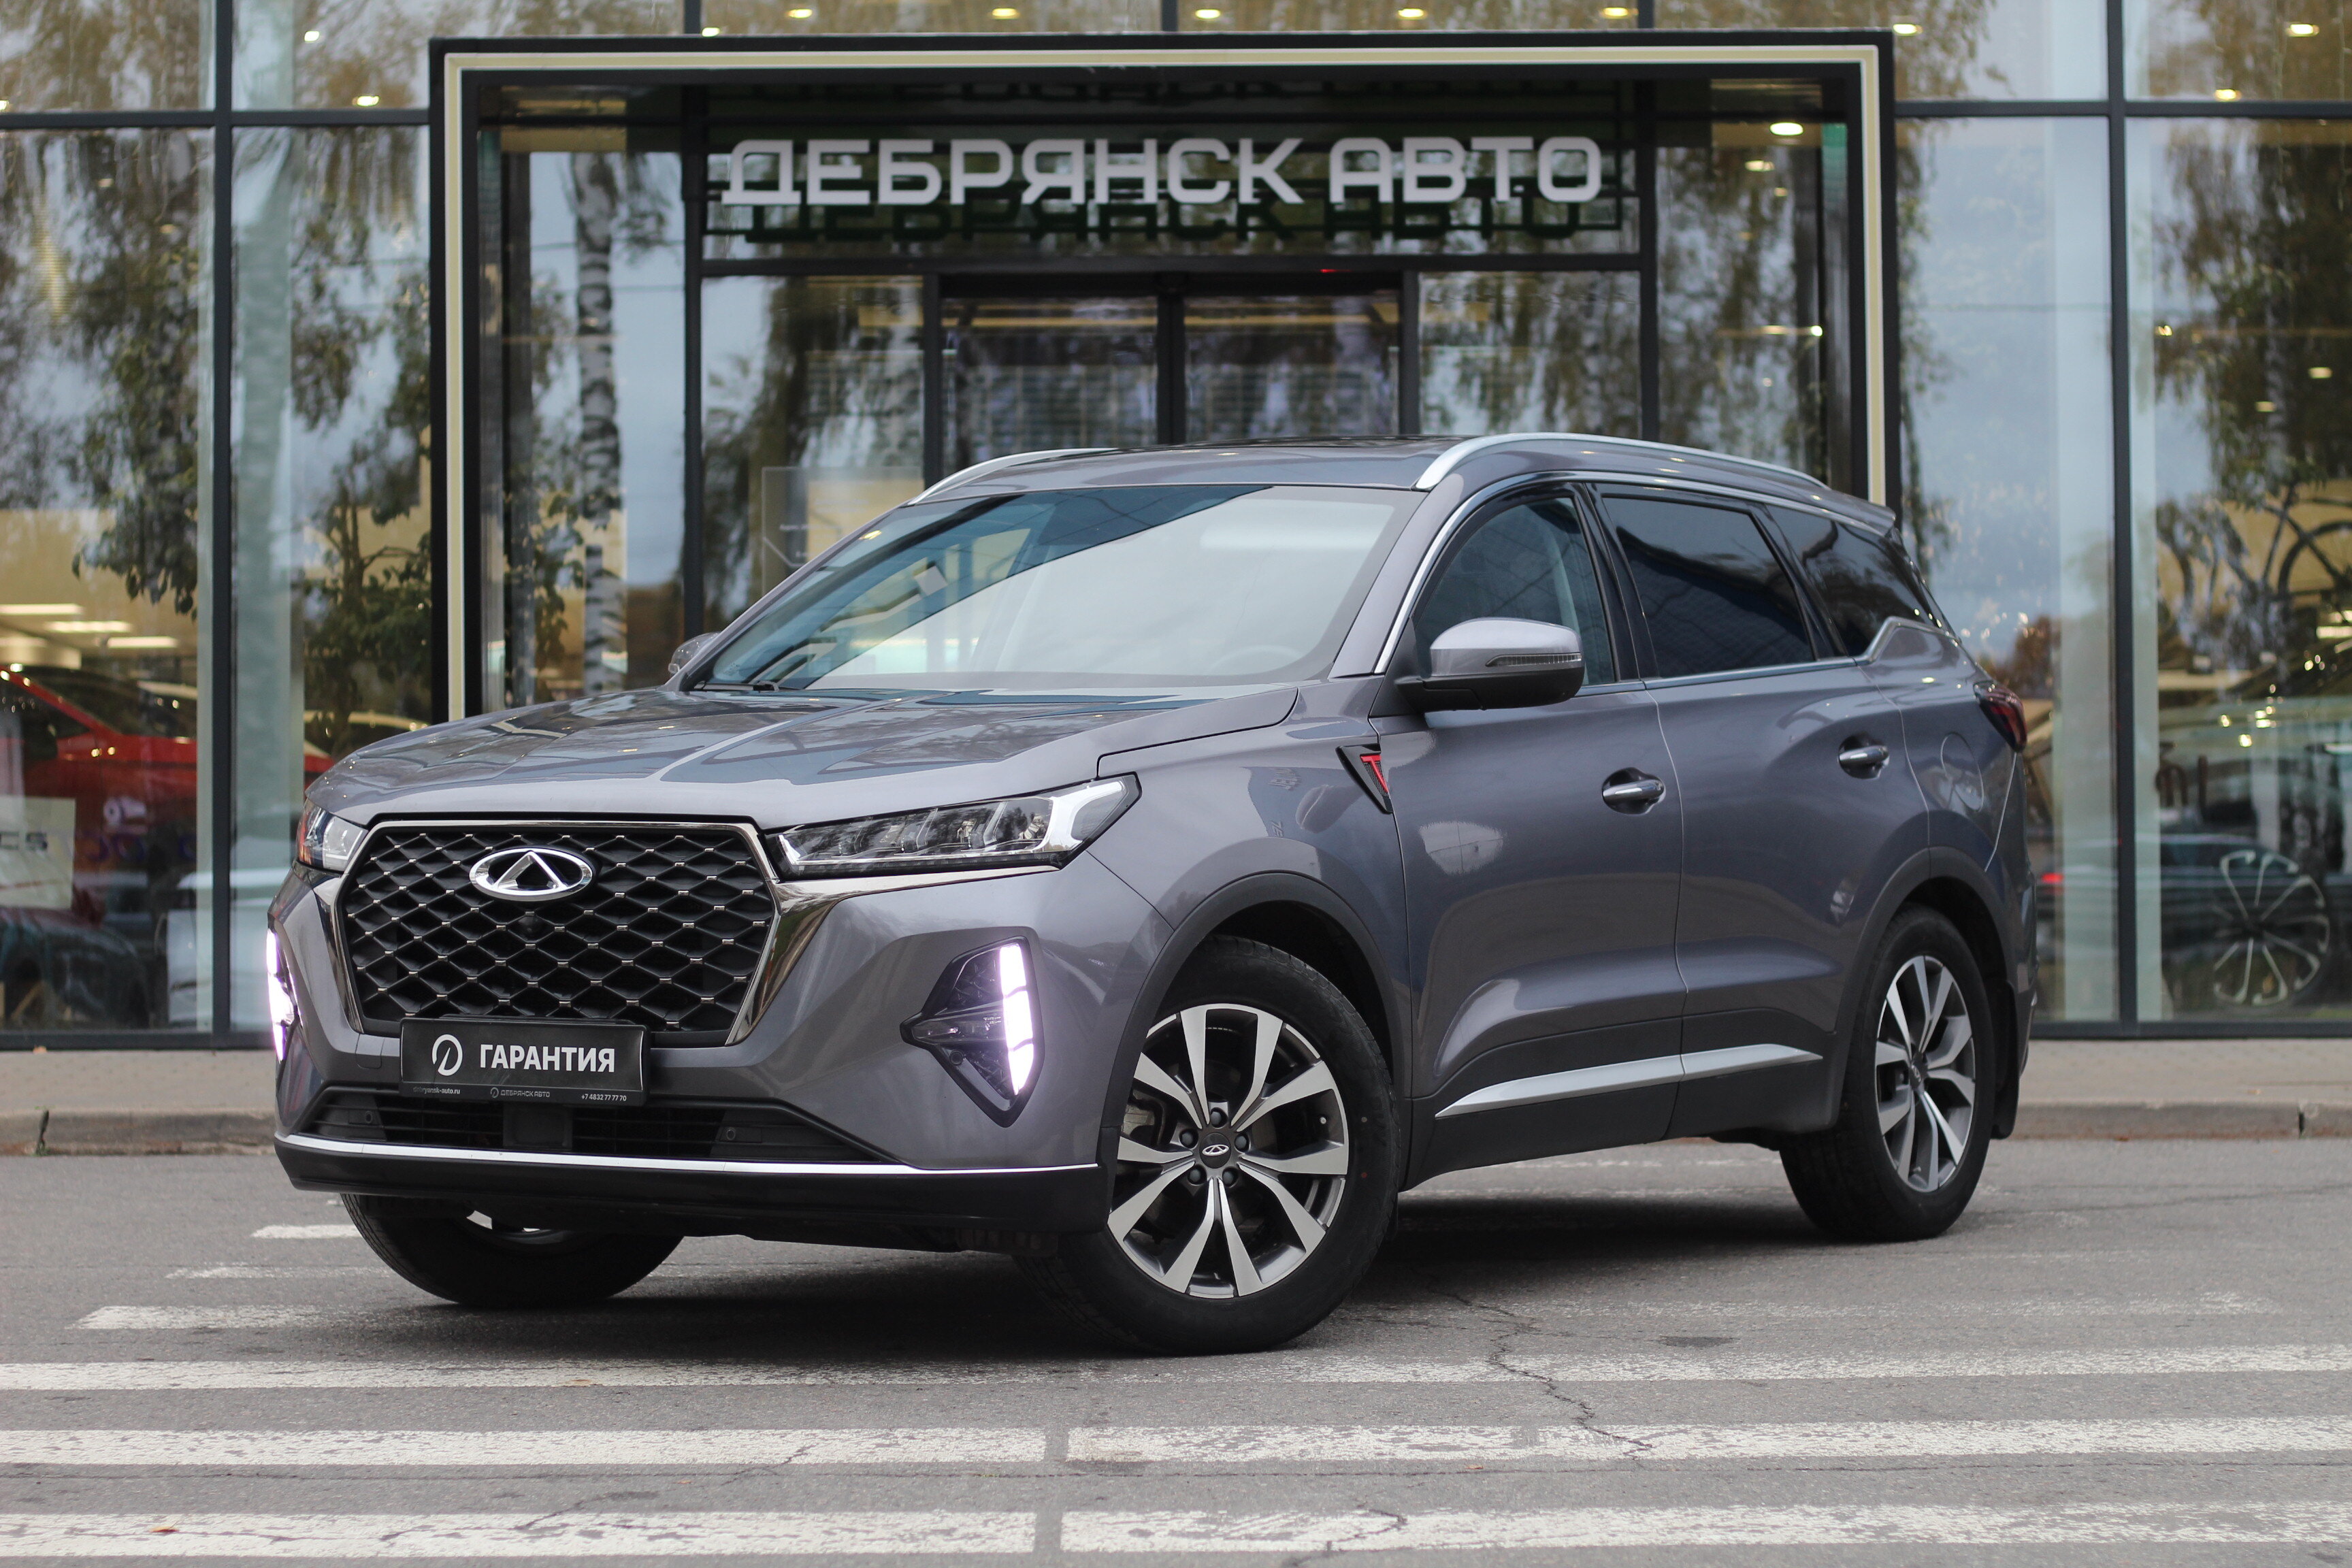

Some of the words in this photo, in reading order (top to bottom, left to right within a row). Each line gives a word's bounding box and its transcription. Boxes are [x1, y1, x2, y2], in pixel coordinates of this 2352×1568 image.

[721, 138, 1305, 205] ДЕБРЯНСК
[1328, 137, 1602, 203] АВТО
[480, 1043, 615, 1073] ГАРАНТИЯ
